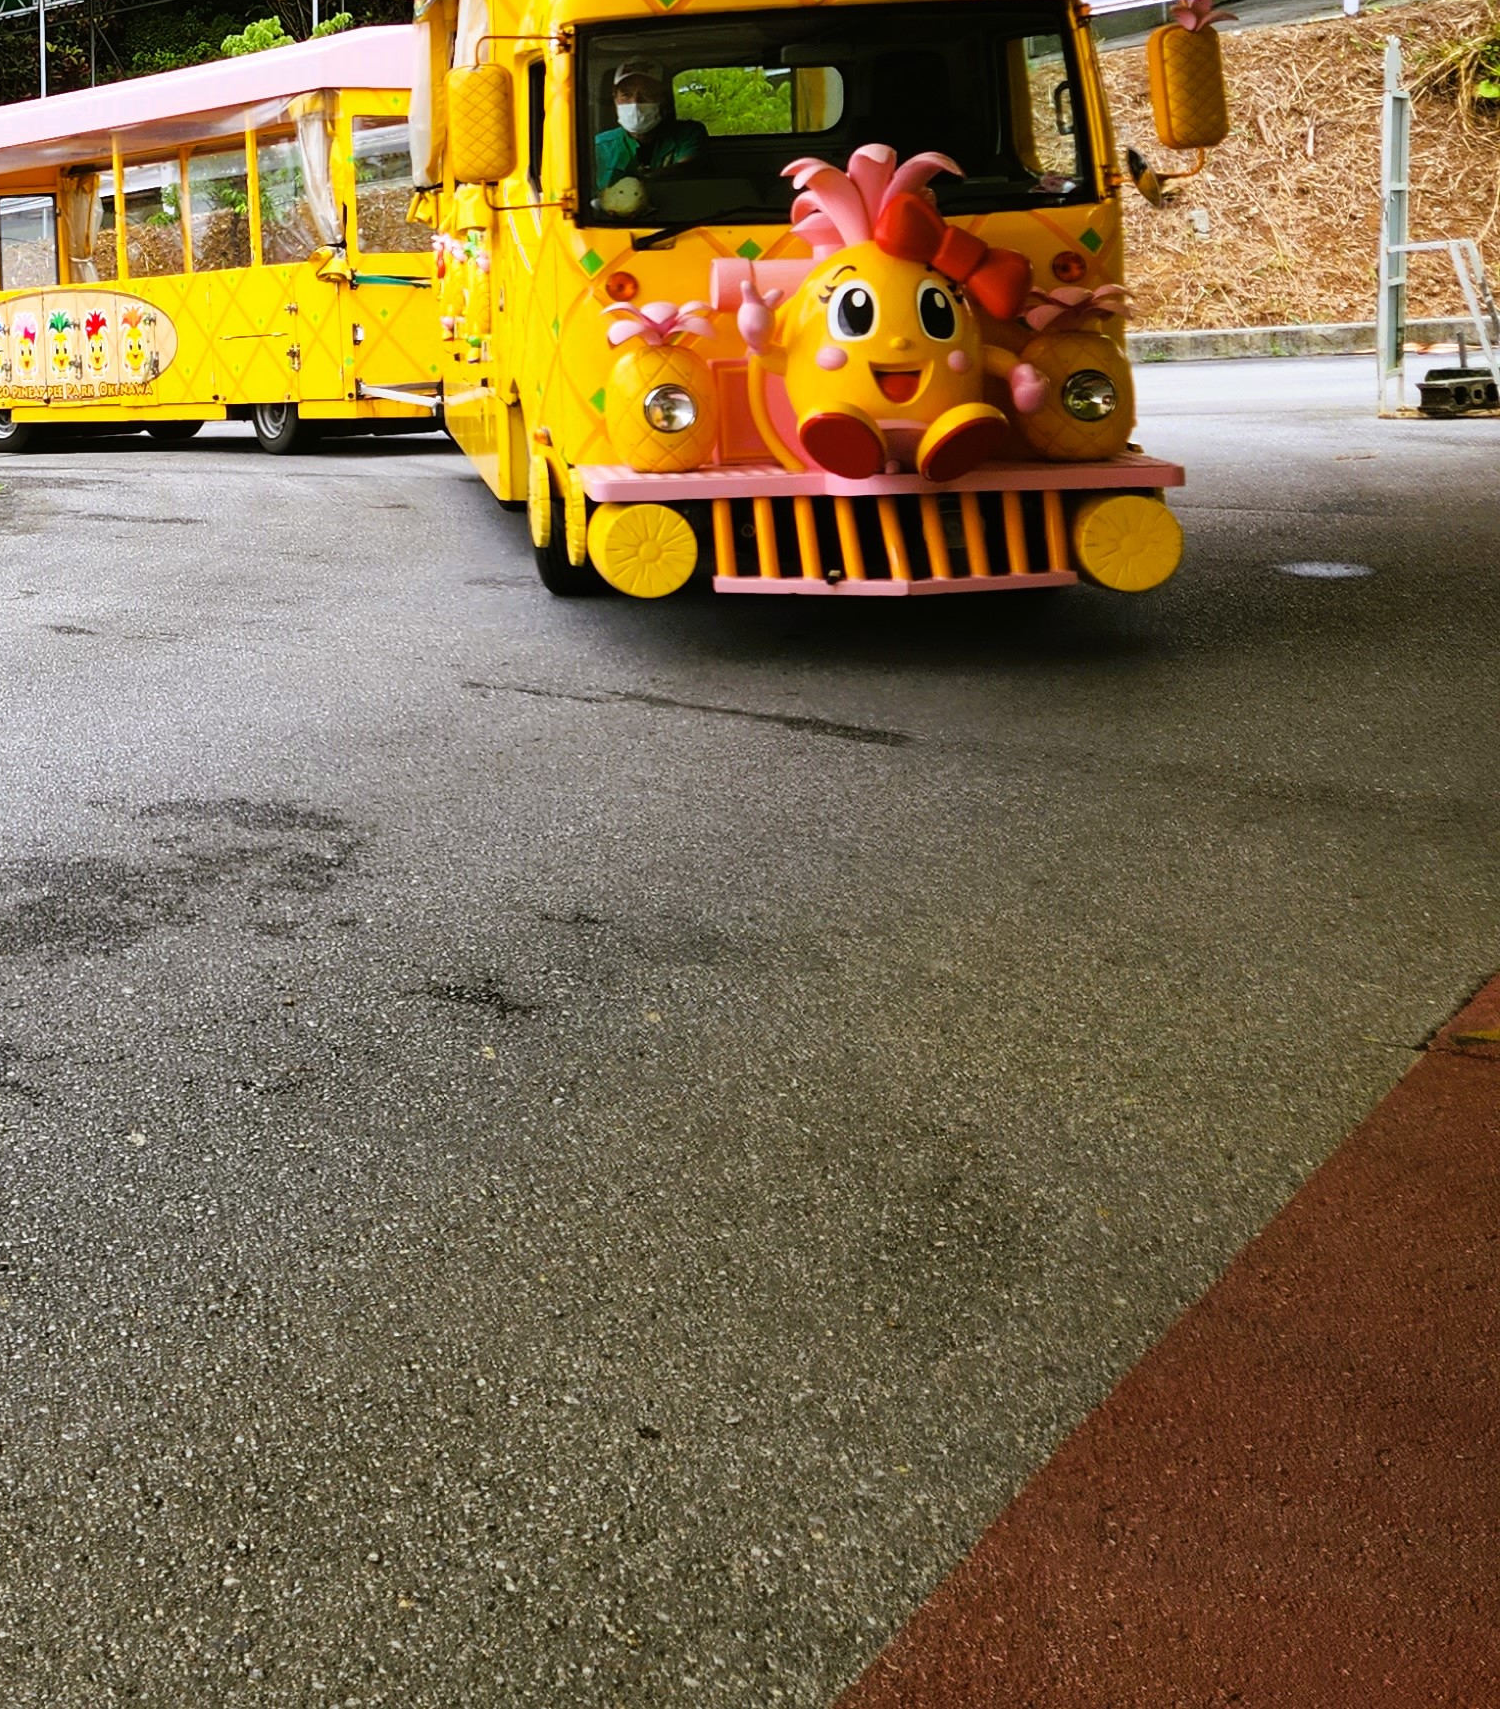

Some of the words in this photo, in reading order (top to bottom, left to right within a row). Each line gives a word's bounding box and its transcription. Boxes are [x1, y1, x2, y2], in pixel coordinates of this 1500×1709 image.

[11, 384, 63, 399] PINEAPPLE
[65, 382, 95, 399] PARK
[99, 380, 153, 397] OKINAWA
